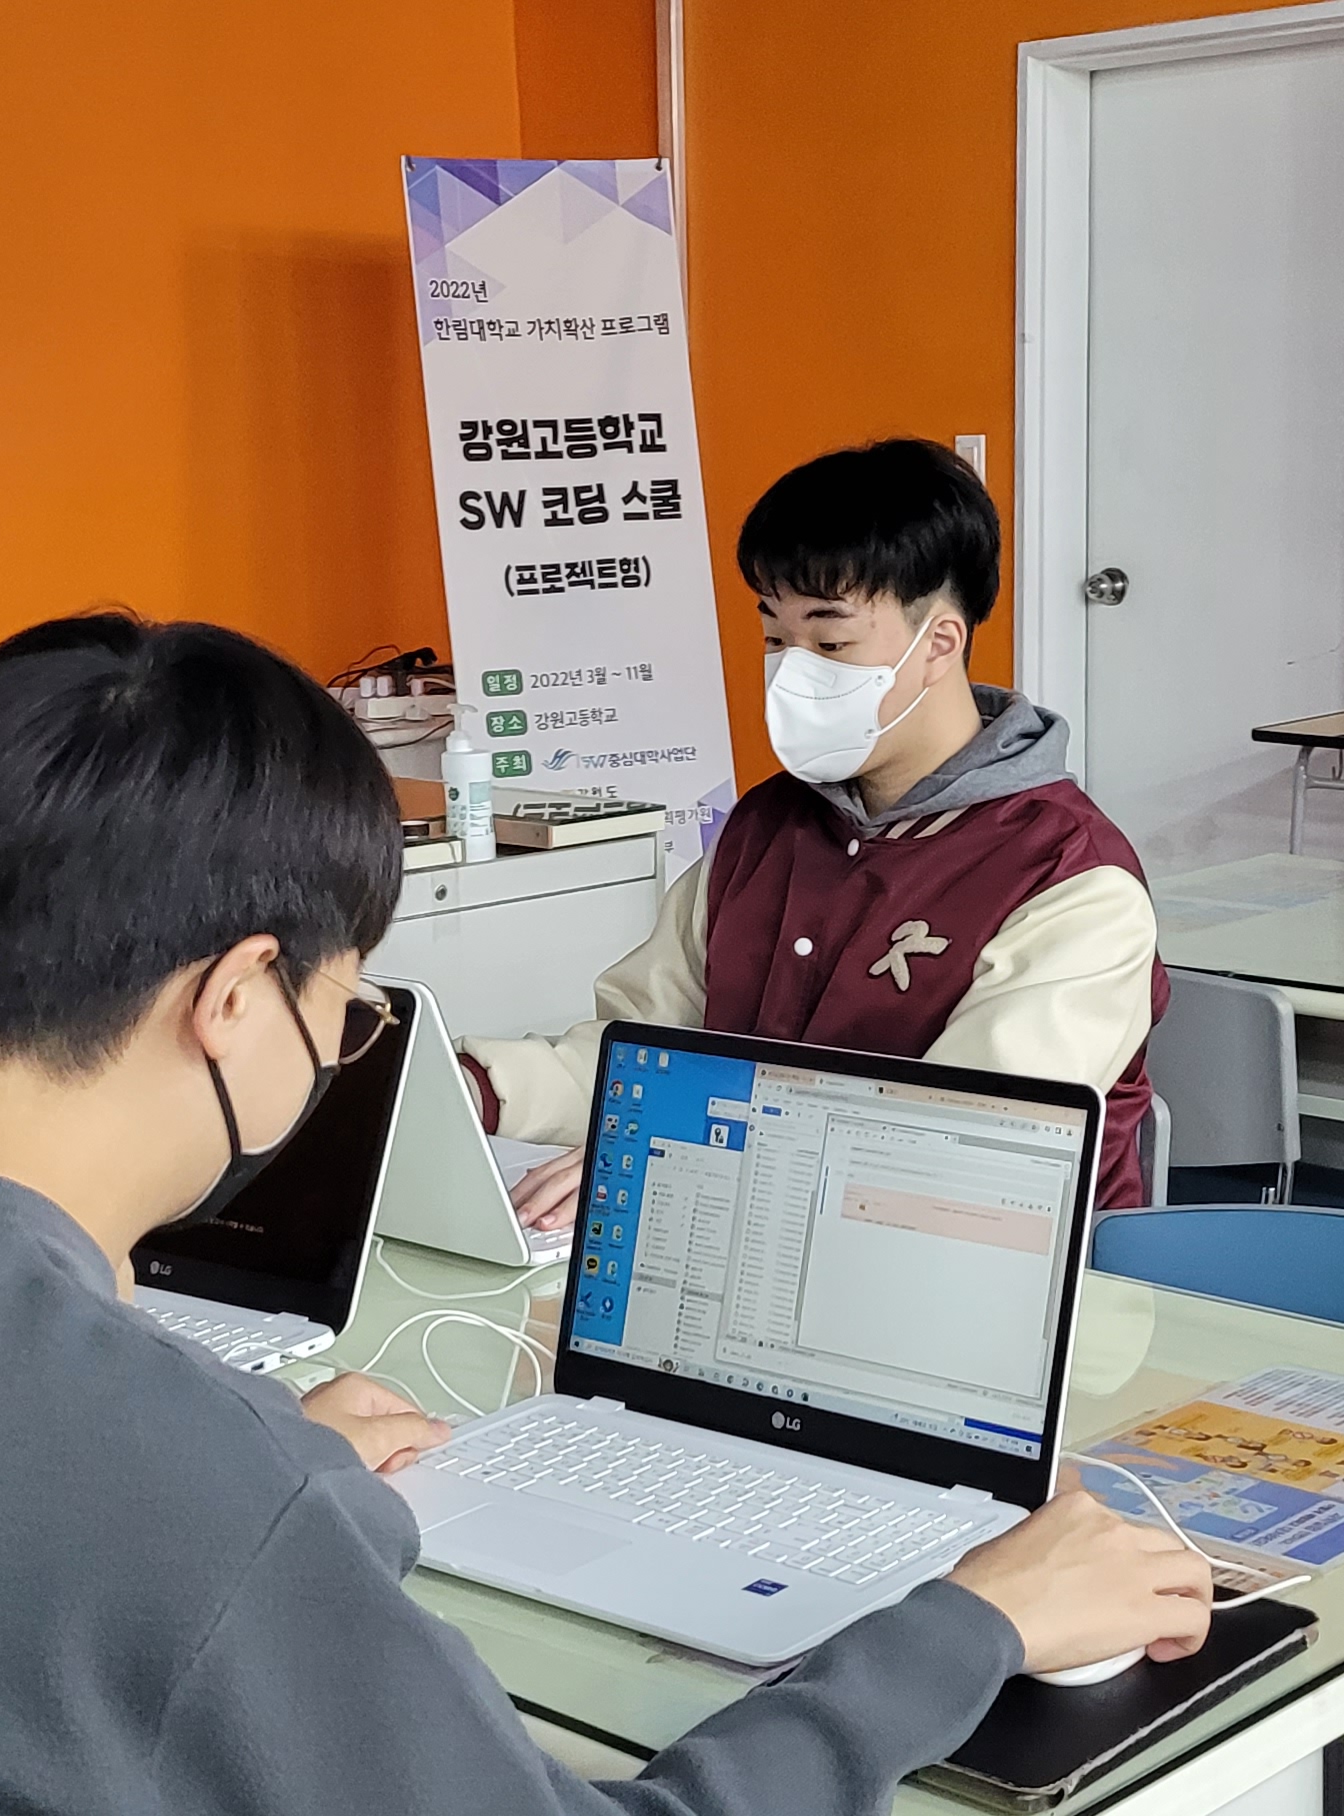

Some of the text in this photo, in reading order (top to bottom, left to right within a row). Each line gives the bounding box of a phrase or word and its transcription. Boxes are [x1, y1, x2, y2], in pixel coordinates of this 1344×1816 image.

[428, 278, 489, 303] 2022년
[433, 312, 671, 342] 한림대학교 가치확산 프로그램
[458, 412, 668, 462] 강원고등학교
[458, 477, 683, 531] SW 코딩 스쿨
[503, 554, 652, 599] (프로젝트형)
[485, 674, 519, 692] 일정
[529, 668, 584, 690] 2022년
[587, 665, 608, 686] 3월
[626, 663, 654, 684] 11월
[489, 708, 619, 733] 장소 강원고등학교
[495, 754, 528, 773] 주최
